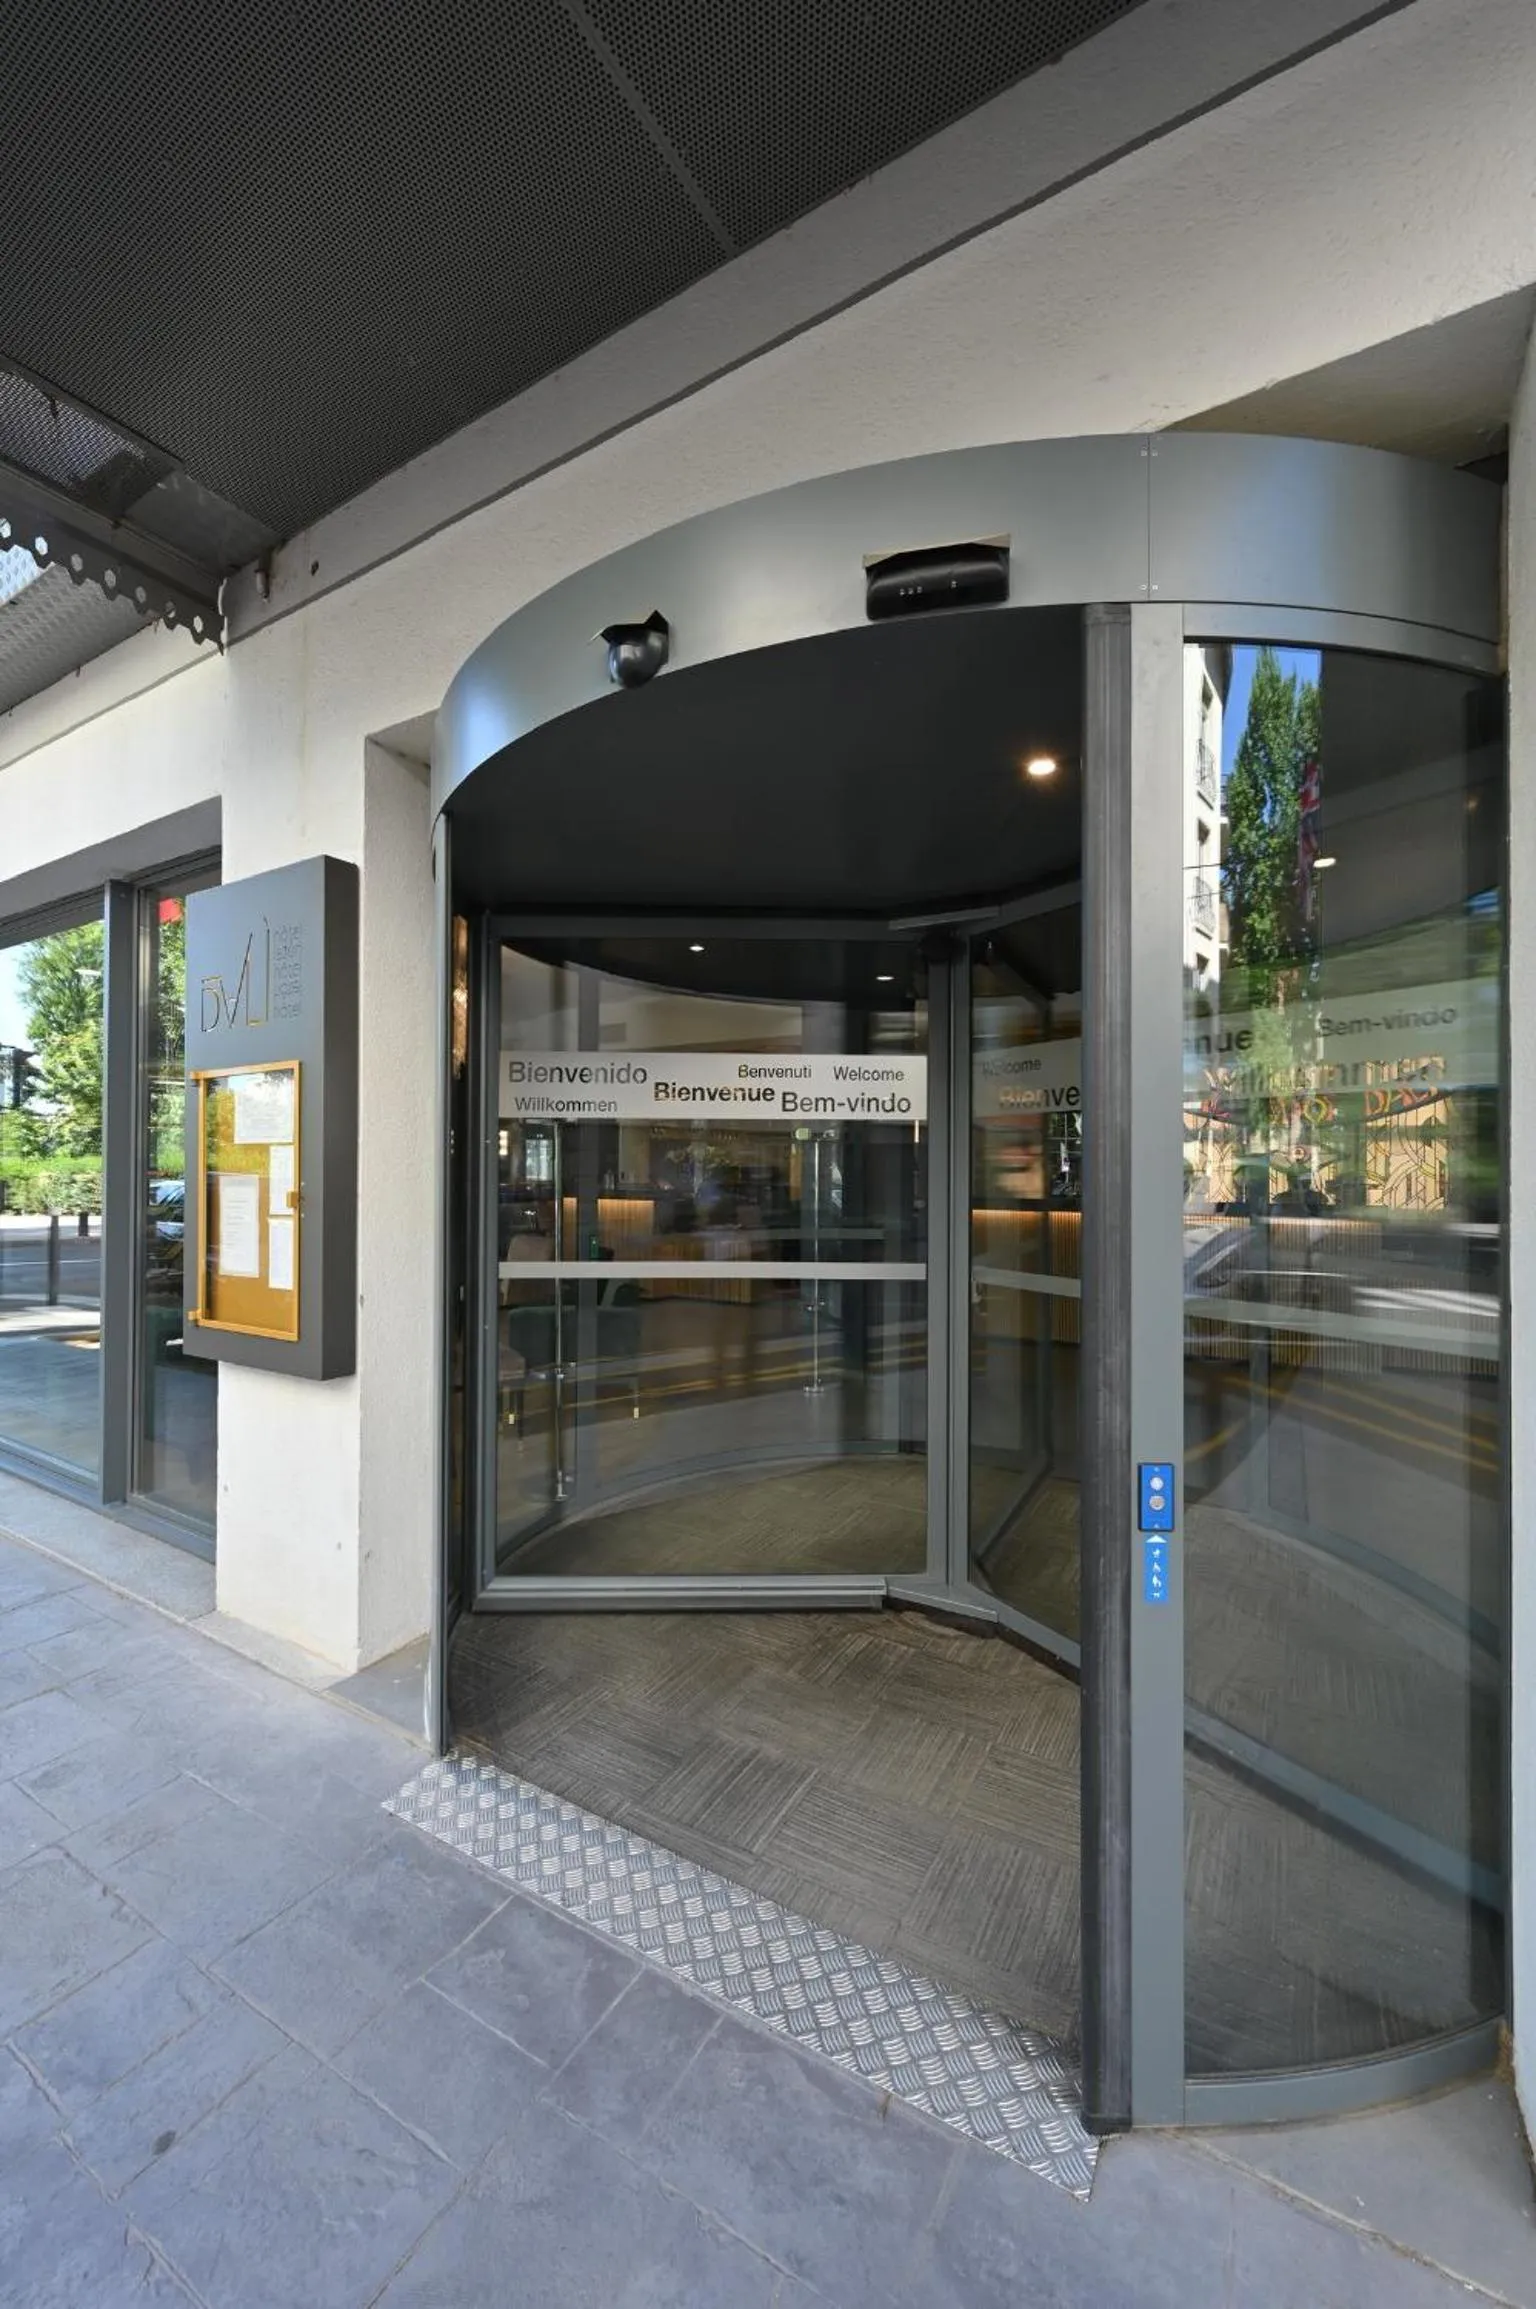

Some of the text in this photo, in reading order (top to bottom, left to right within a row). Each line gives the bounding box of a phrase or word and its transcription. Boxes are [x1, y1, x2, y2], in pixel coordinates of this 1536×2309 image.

[508, 1061, 648, 1084] Bienvenido
[738, 1064, 905, 1081] Benvenuti Welcome
[514, 1096, 618, 1113] Willkommen
[653, 1081, 911, 1113] Bienvenue Bem-vindo
